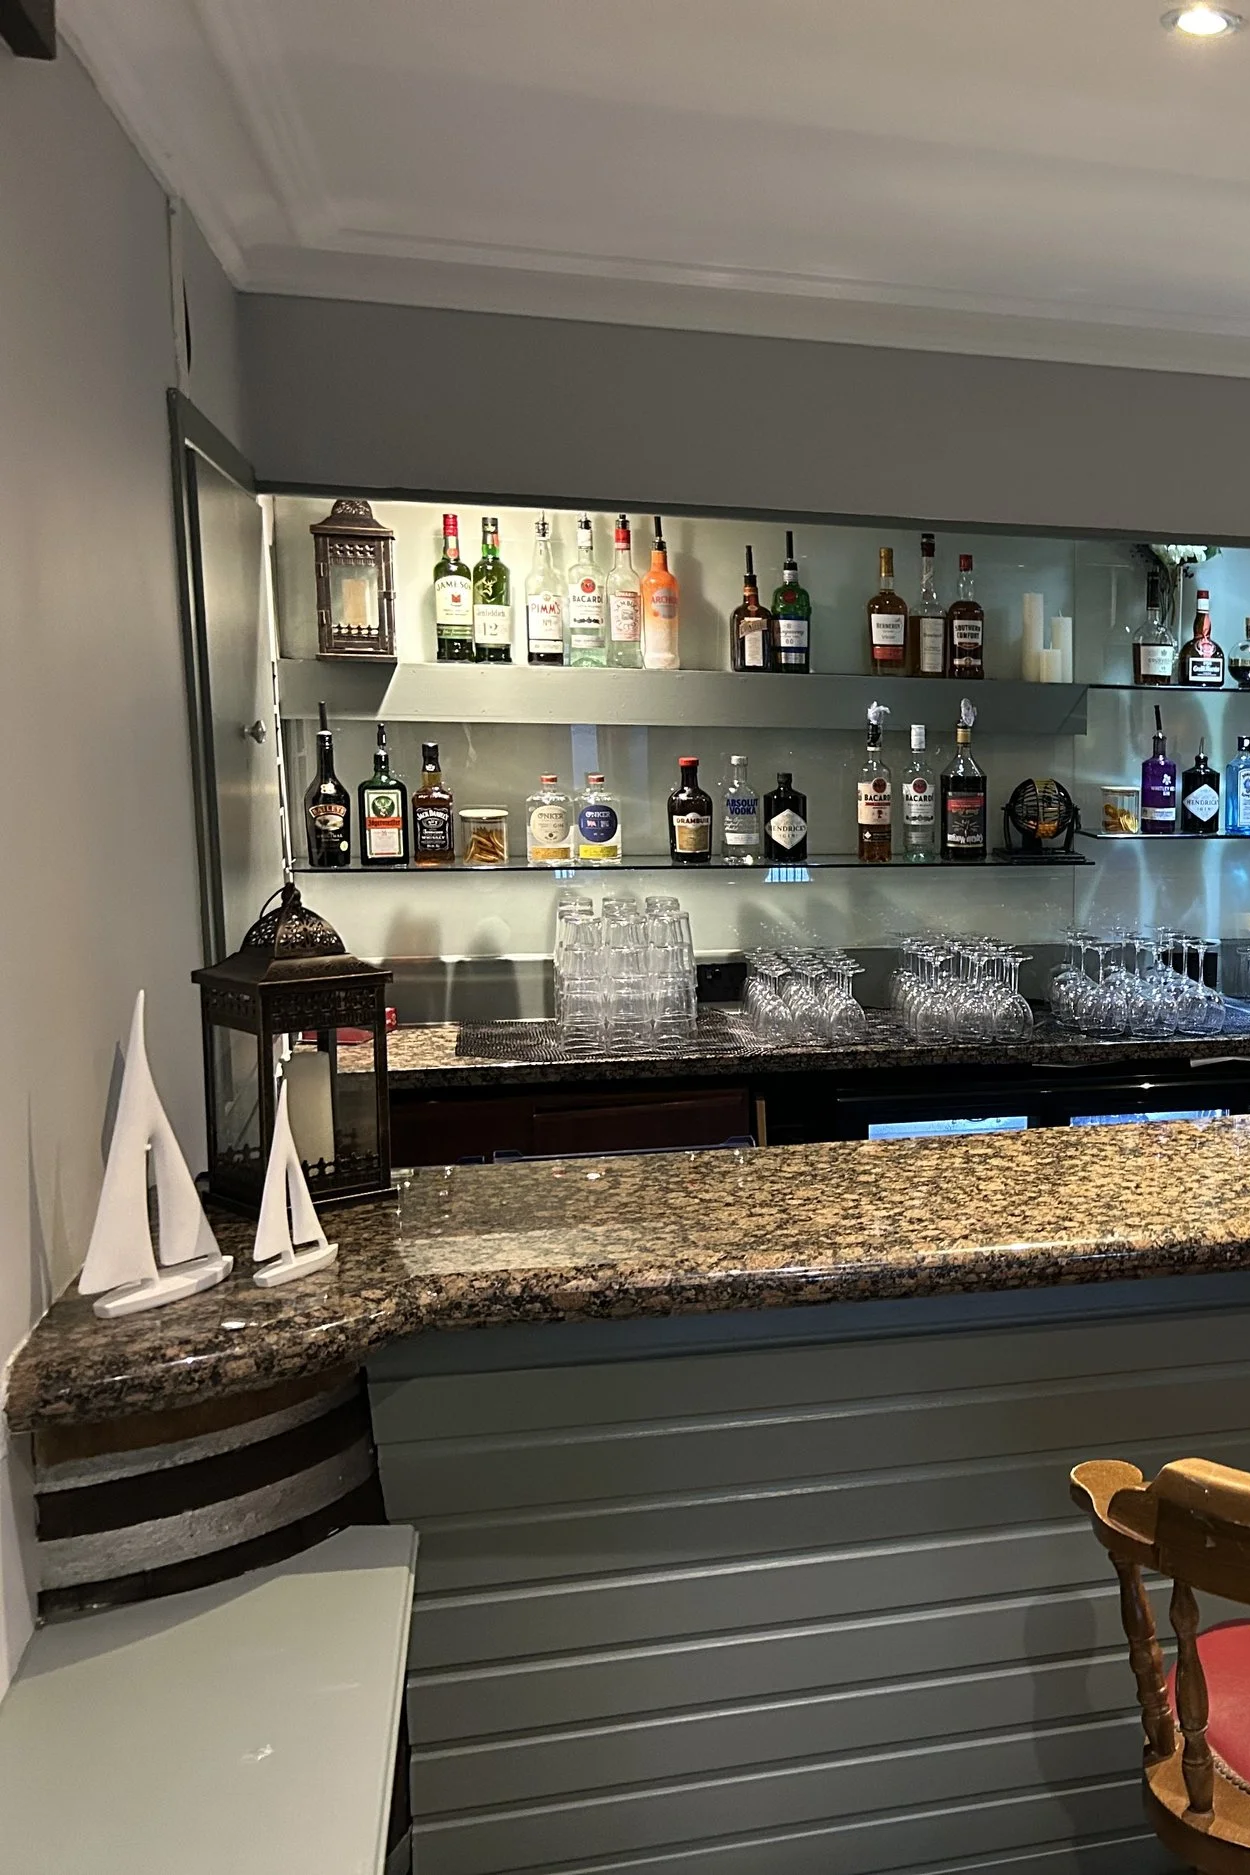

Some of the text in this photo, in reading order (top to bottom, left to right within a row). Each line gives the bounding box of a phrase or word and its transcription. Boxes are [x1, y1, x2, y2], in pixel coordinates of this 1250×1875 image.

[531, 602, 561, 615] PIMM'S
[726, 799, 758, 807] ABSOLUT
[312, 806, 345, 816] BAILEYS
[730, 807, 756, 815] VODKA
